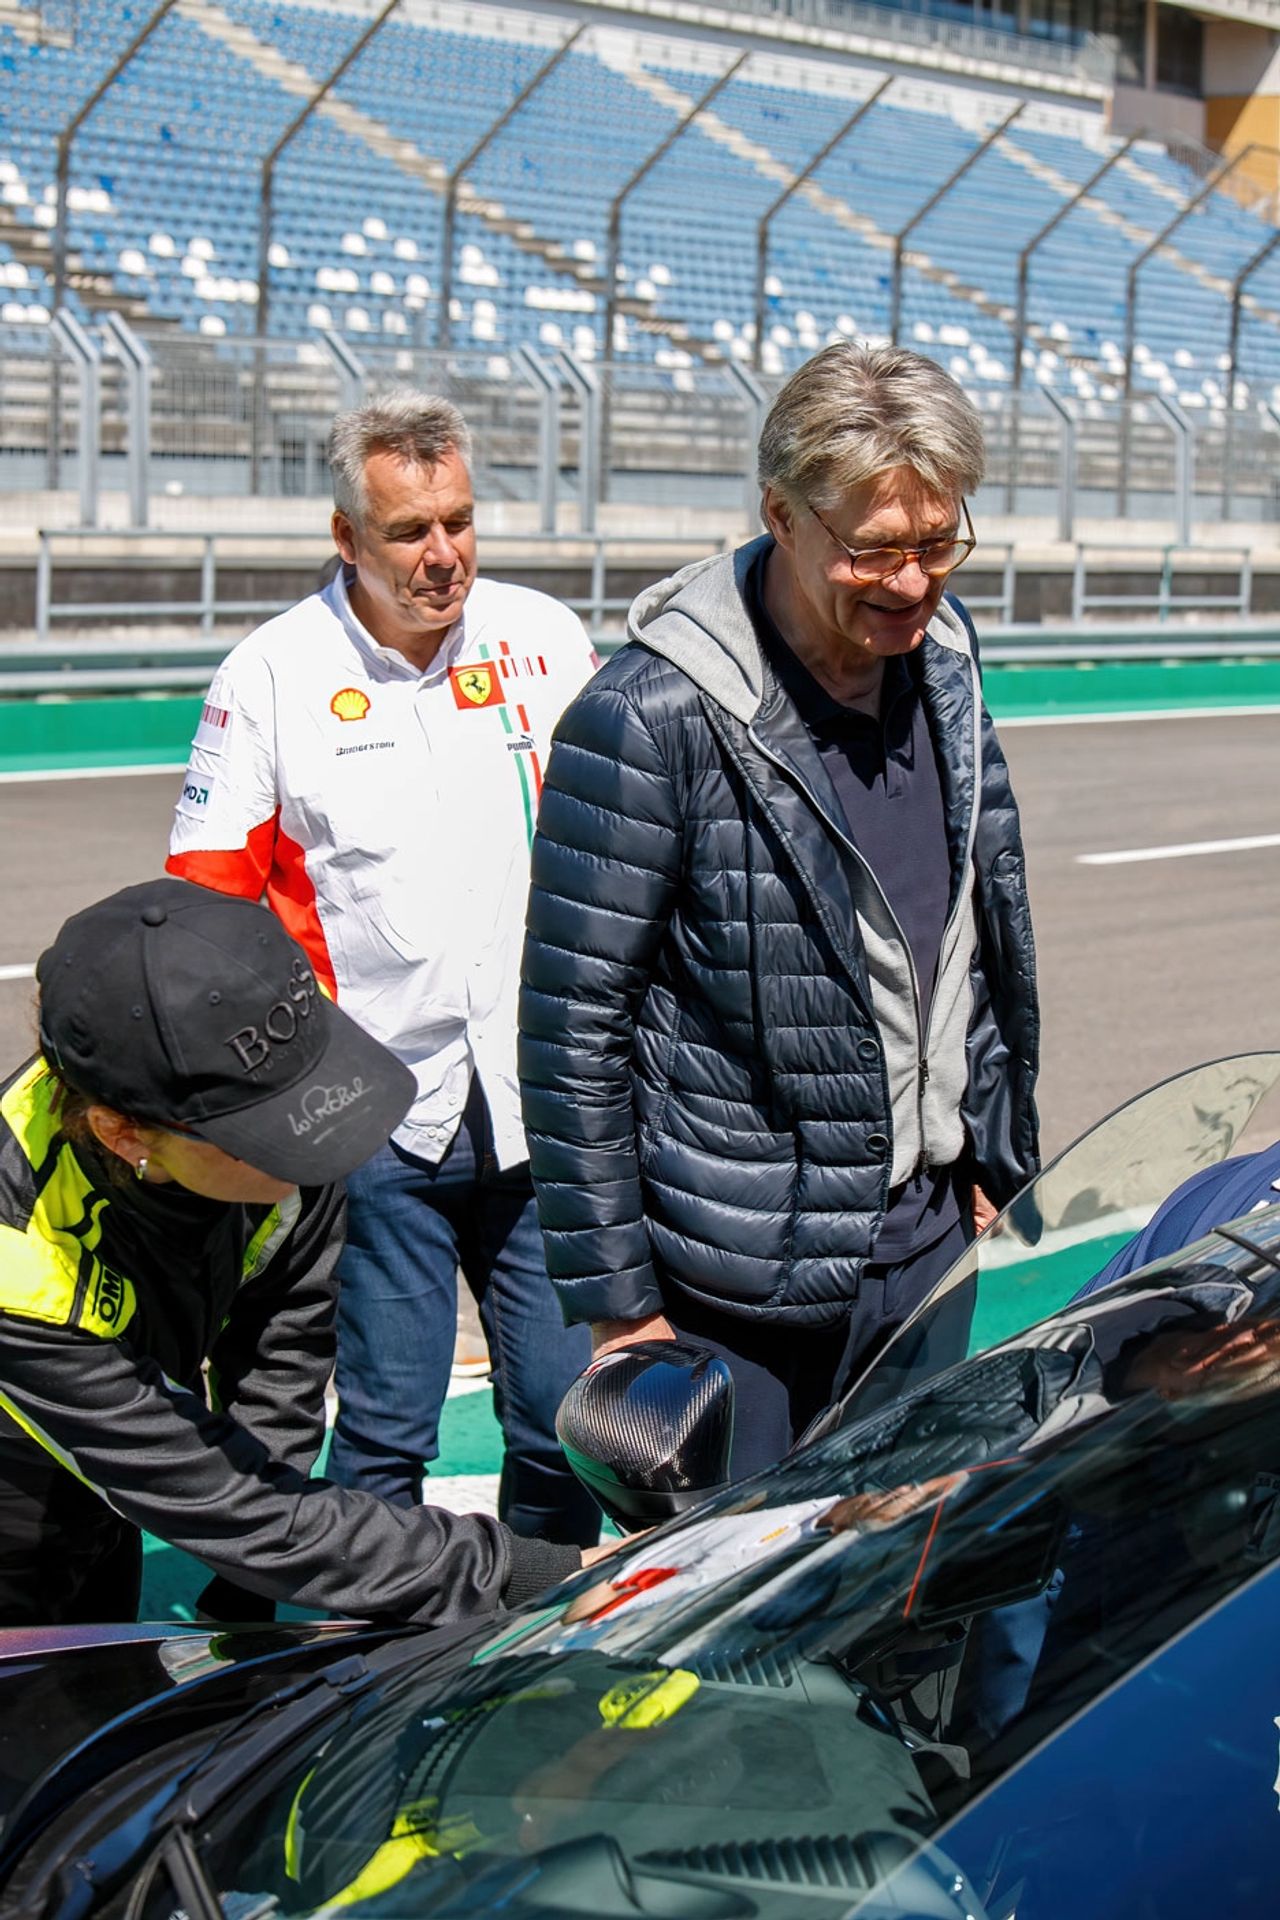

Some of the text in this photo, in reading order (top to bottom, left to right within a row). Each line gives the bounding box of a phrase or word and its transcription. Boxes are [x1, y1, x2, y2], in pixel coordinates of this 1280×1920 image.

[506, 741, 533, 751] PUMA
[224, 958, 315, 1074] BOSS
[100, 1268, 121, 1323] OM
